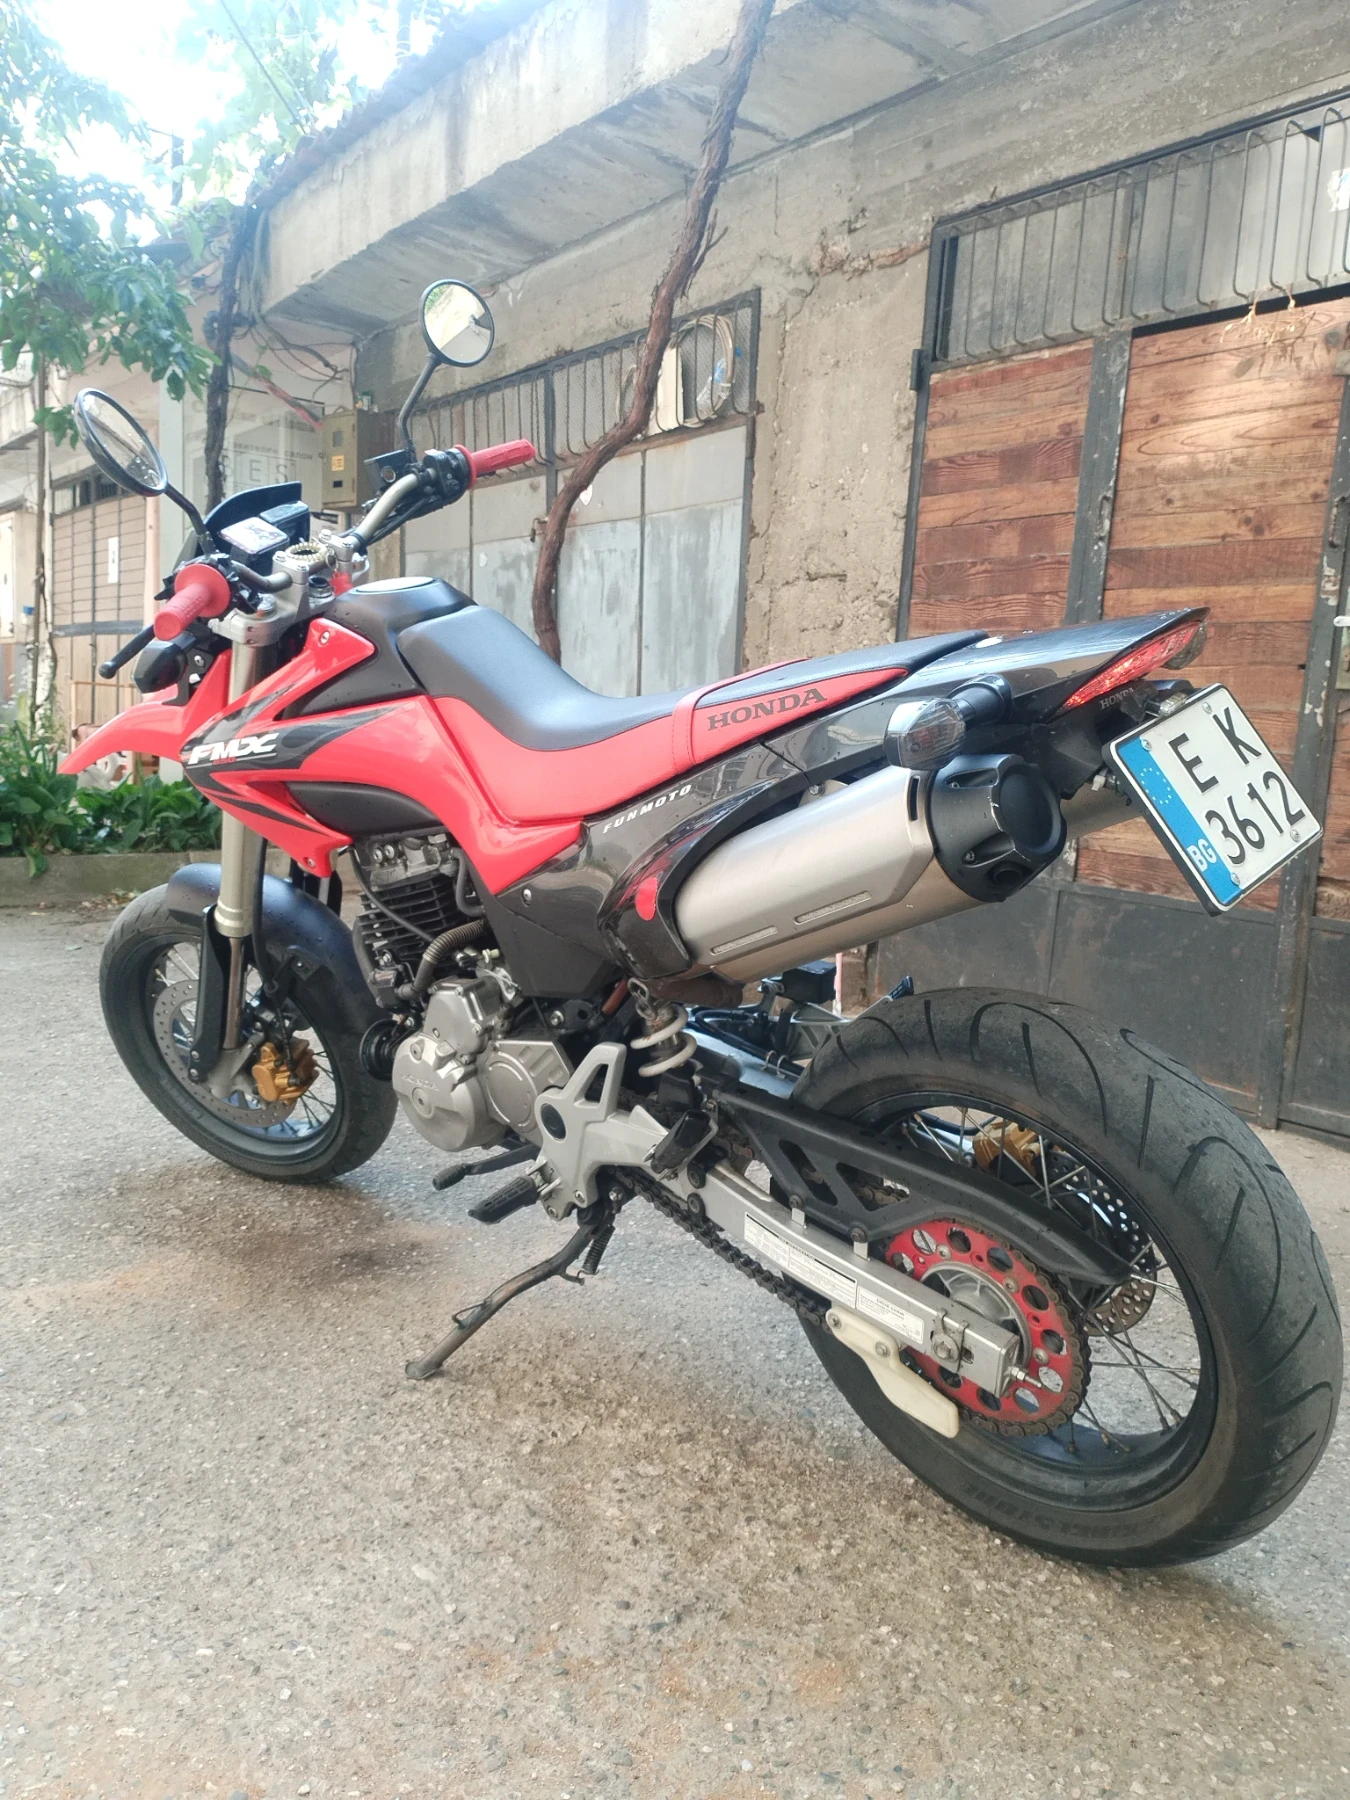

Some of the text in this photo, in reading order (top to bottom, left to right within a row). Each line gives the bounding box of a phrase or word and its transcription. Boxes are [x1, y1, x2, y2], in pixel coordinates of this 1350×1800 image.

[708, 688, 828, 731] HONDA
[187, 733, 280, 765] FMX
[1168, 706, 1262, 794] E K
[602, 784, 692, 834] FUNMOTO
[1204, 770, 1306, 865] 3612
[1186, 838, 1217, 872] BG
